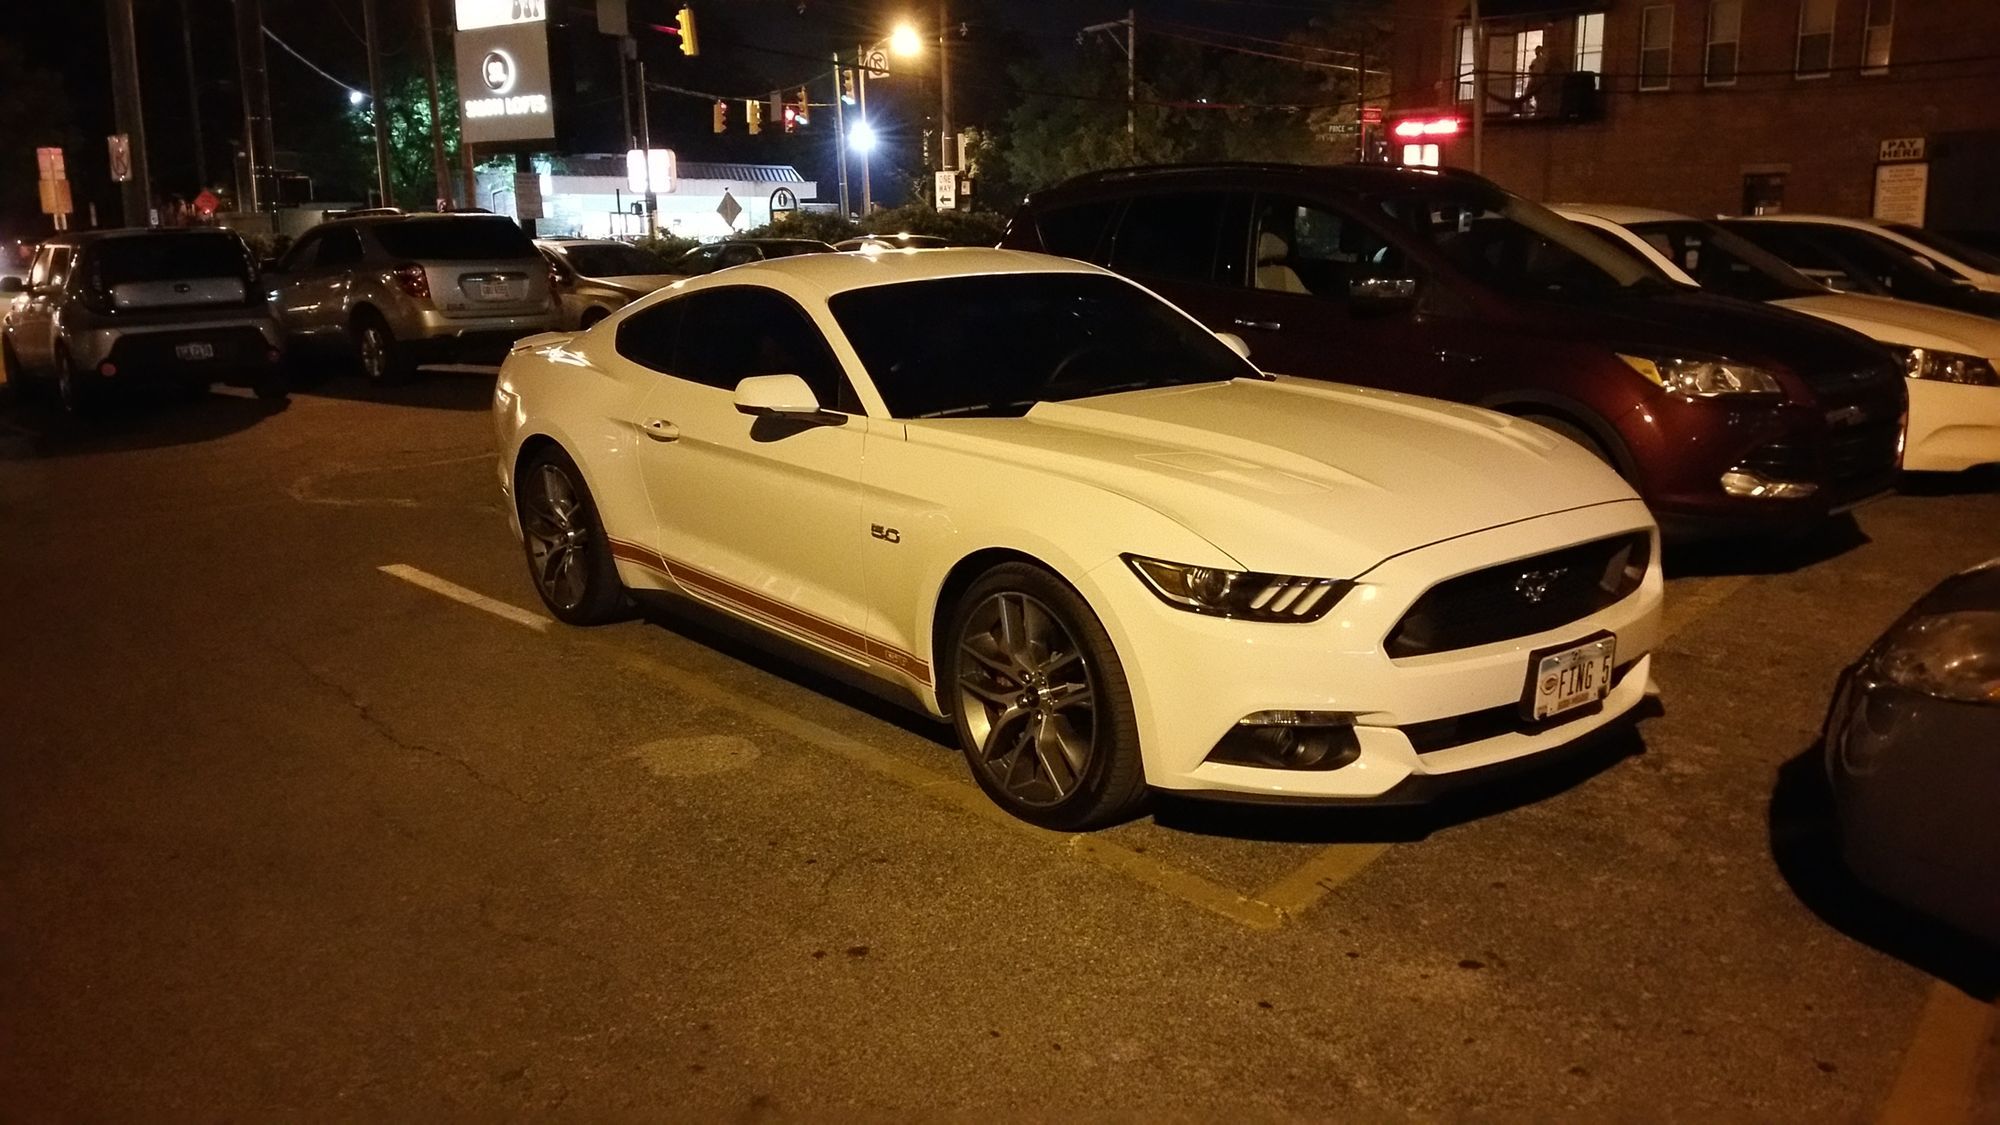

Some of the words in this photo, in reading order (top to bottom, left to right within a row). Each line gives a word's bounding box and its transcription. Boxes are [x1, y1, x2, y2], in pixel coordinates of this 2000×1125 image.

[1888, 140, 1916, 149] PAY
[1882, 148, 1920, 158] HERE
[1558, 660, 1594, 699] FING
[1601, 655, 1611, 684] 5
